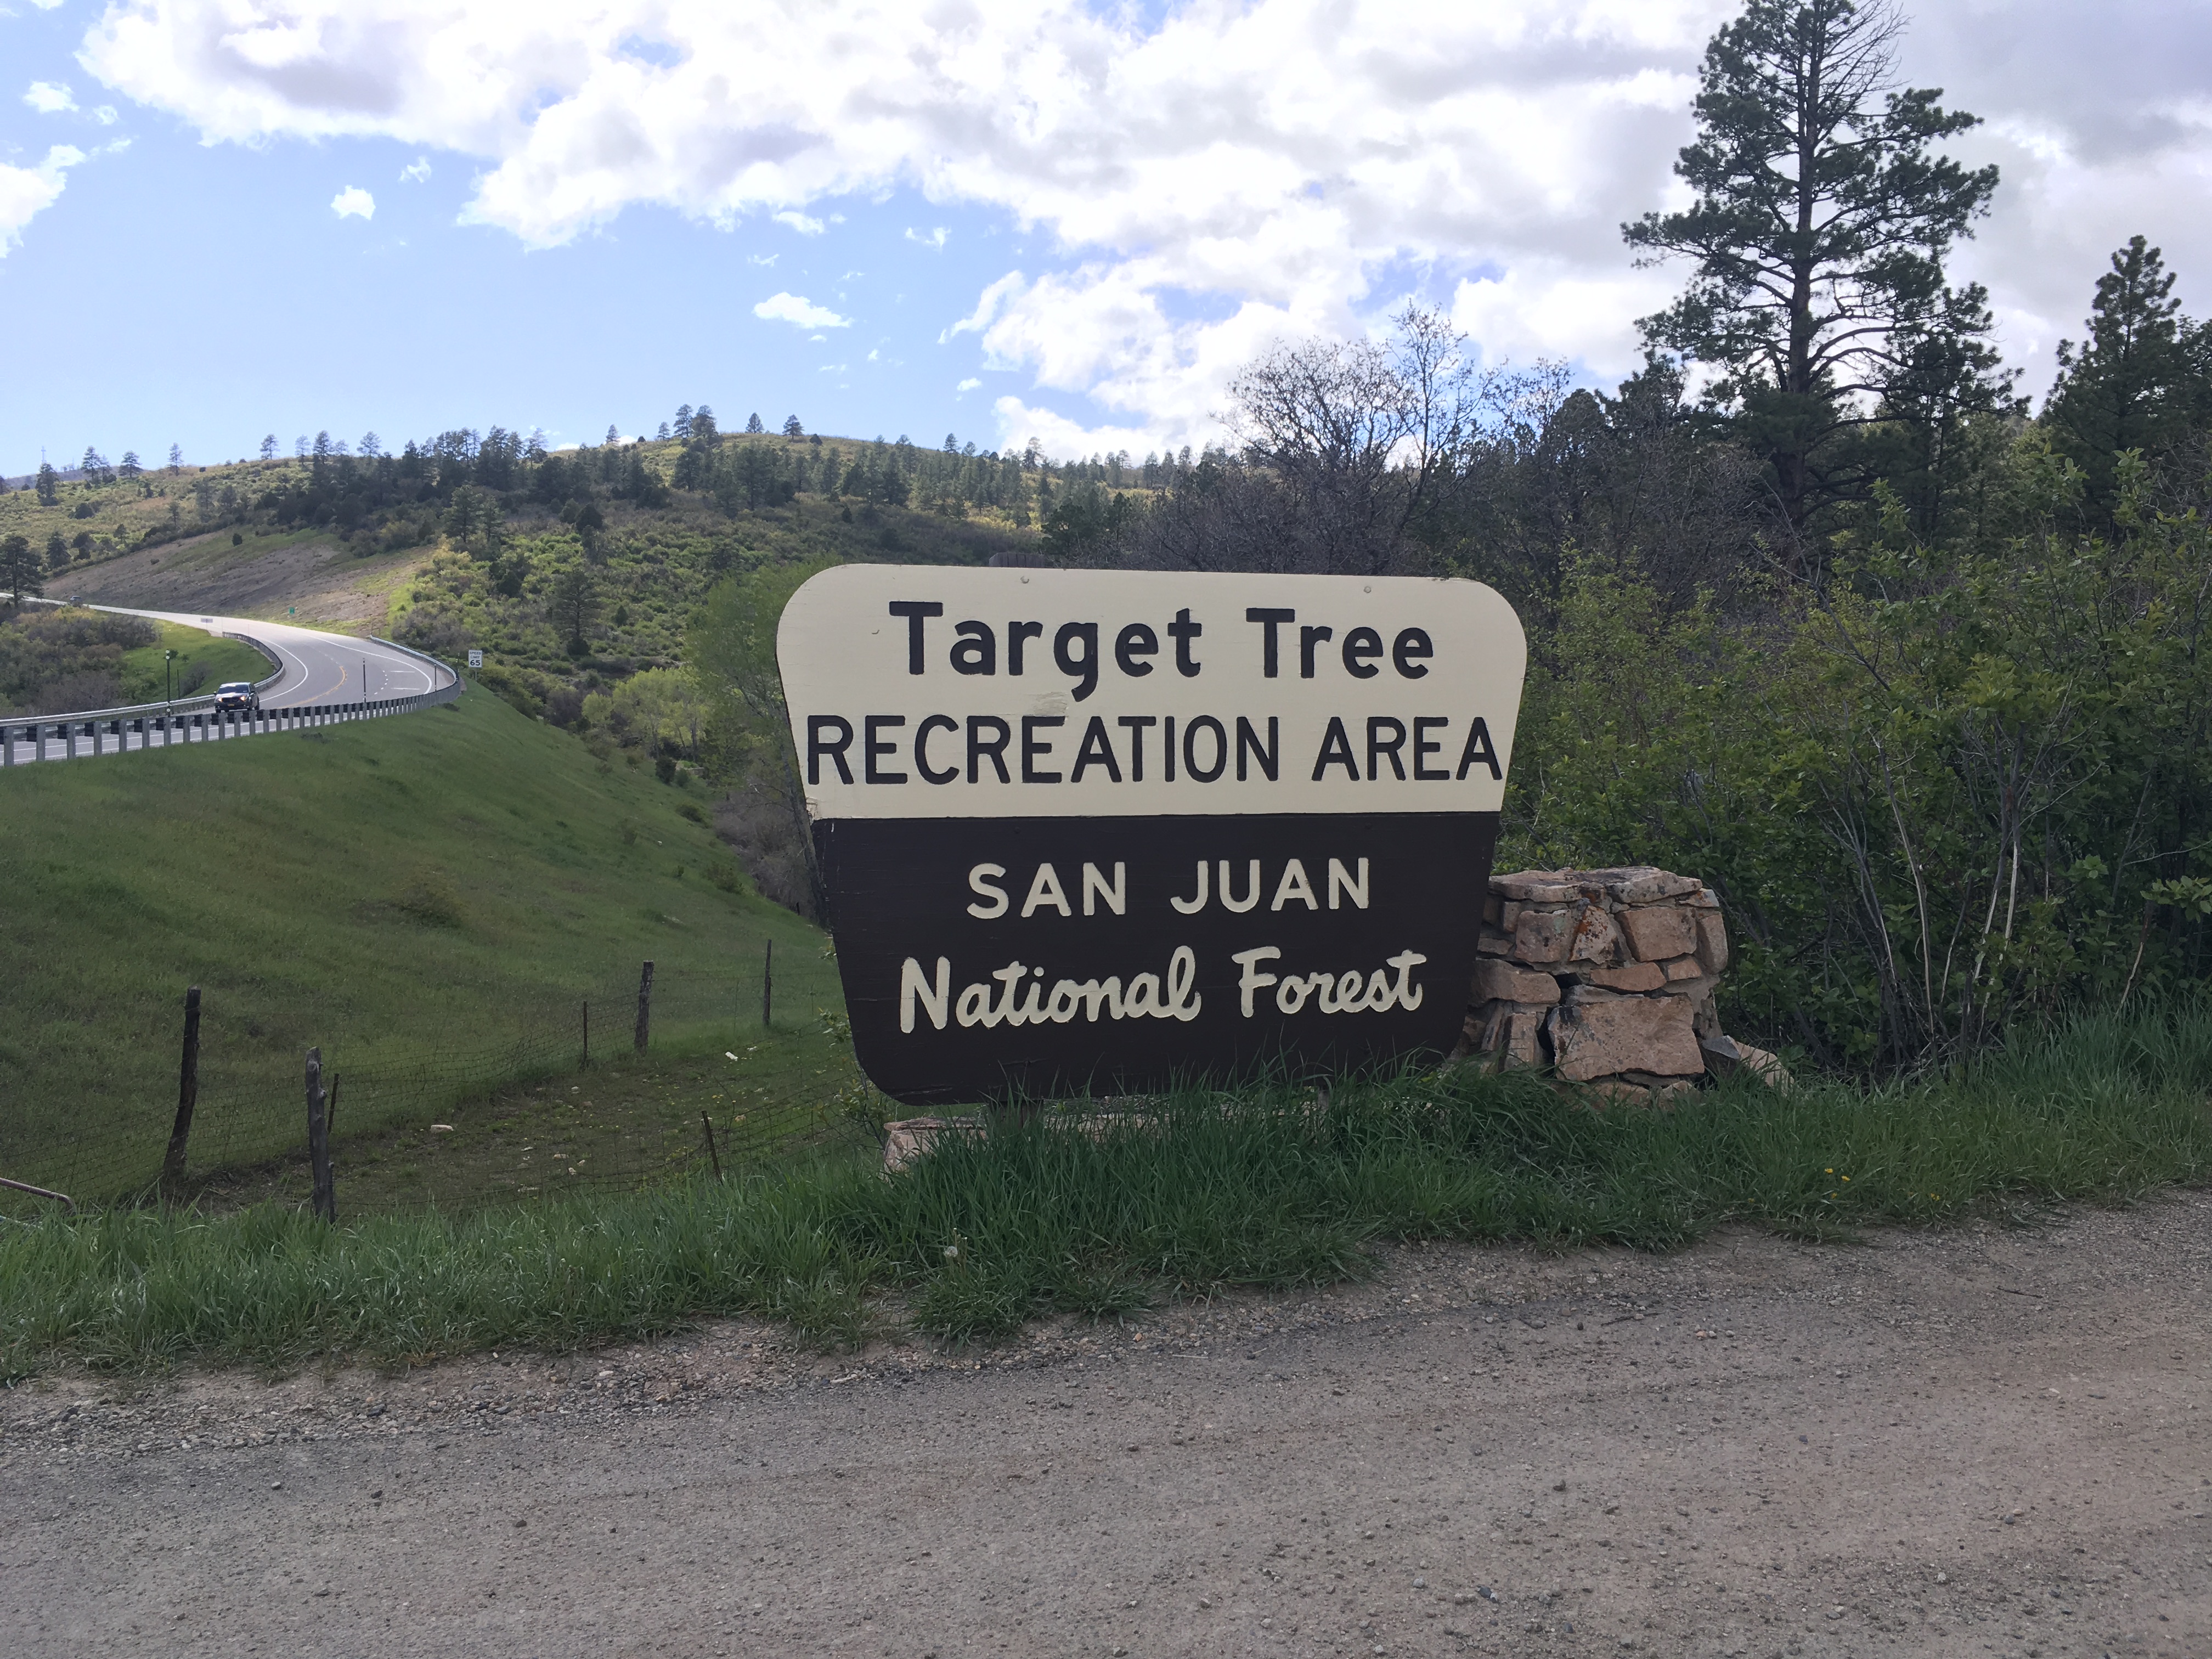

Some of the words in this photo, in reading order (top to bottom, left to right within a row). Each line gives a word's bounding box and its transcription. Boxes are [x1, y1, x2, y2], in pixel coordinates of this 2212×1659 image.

[889, 600, 1203, 702] Target
[1245, 607, 1434, 680] Tree
[806, 714, 1279, 786] RECREATION
[1311, 715, 1503, 782] AREA
[966, 862, 1126, 919] SAN
[1170, 857, 1369, 915] JUAN
[899, 945, 1202, 1034] National
[1231, 946, 1427, 1019] Forest
